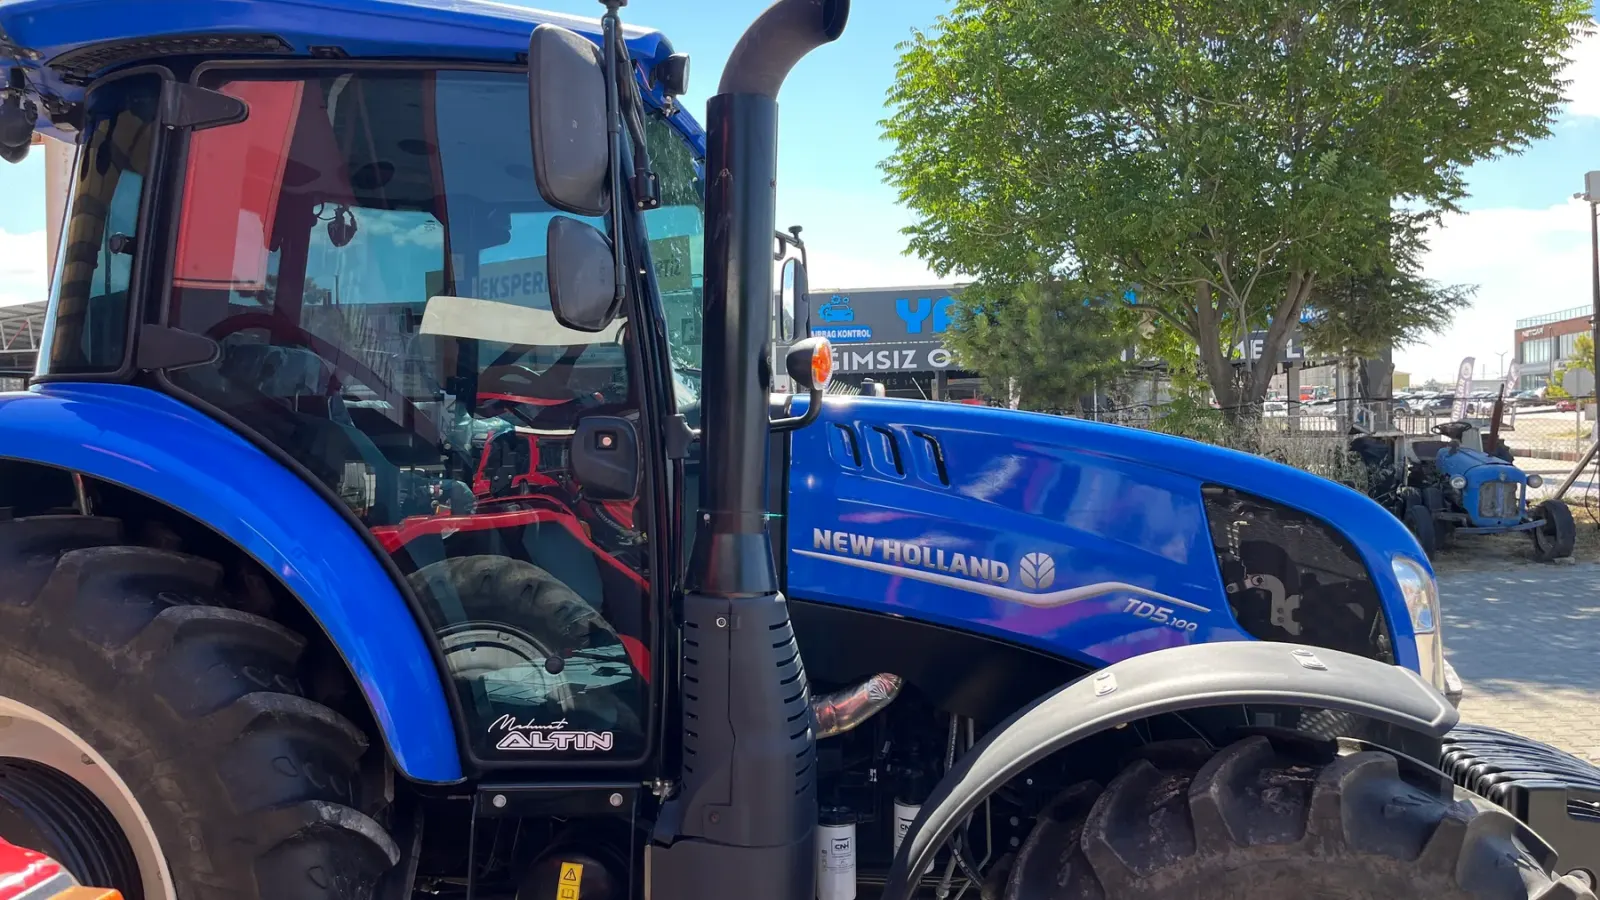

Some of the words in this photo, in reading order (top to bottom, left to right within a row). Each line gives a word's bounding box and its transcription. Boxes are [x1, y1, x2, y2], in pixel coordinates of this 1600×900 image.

[480, 270, 548, 299] EKSPER
[837, 329, 871, 338] KONTROL
[813, 527, 874, 557] NEW
[883, 539, 1010, 583] HOLLAND
[495, 731, 613, 751] ALTIN
